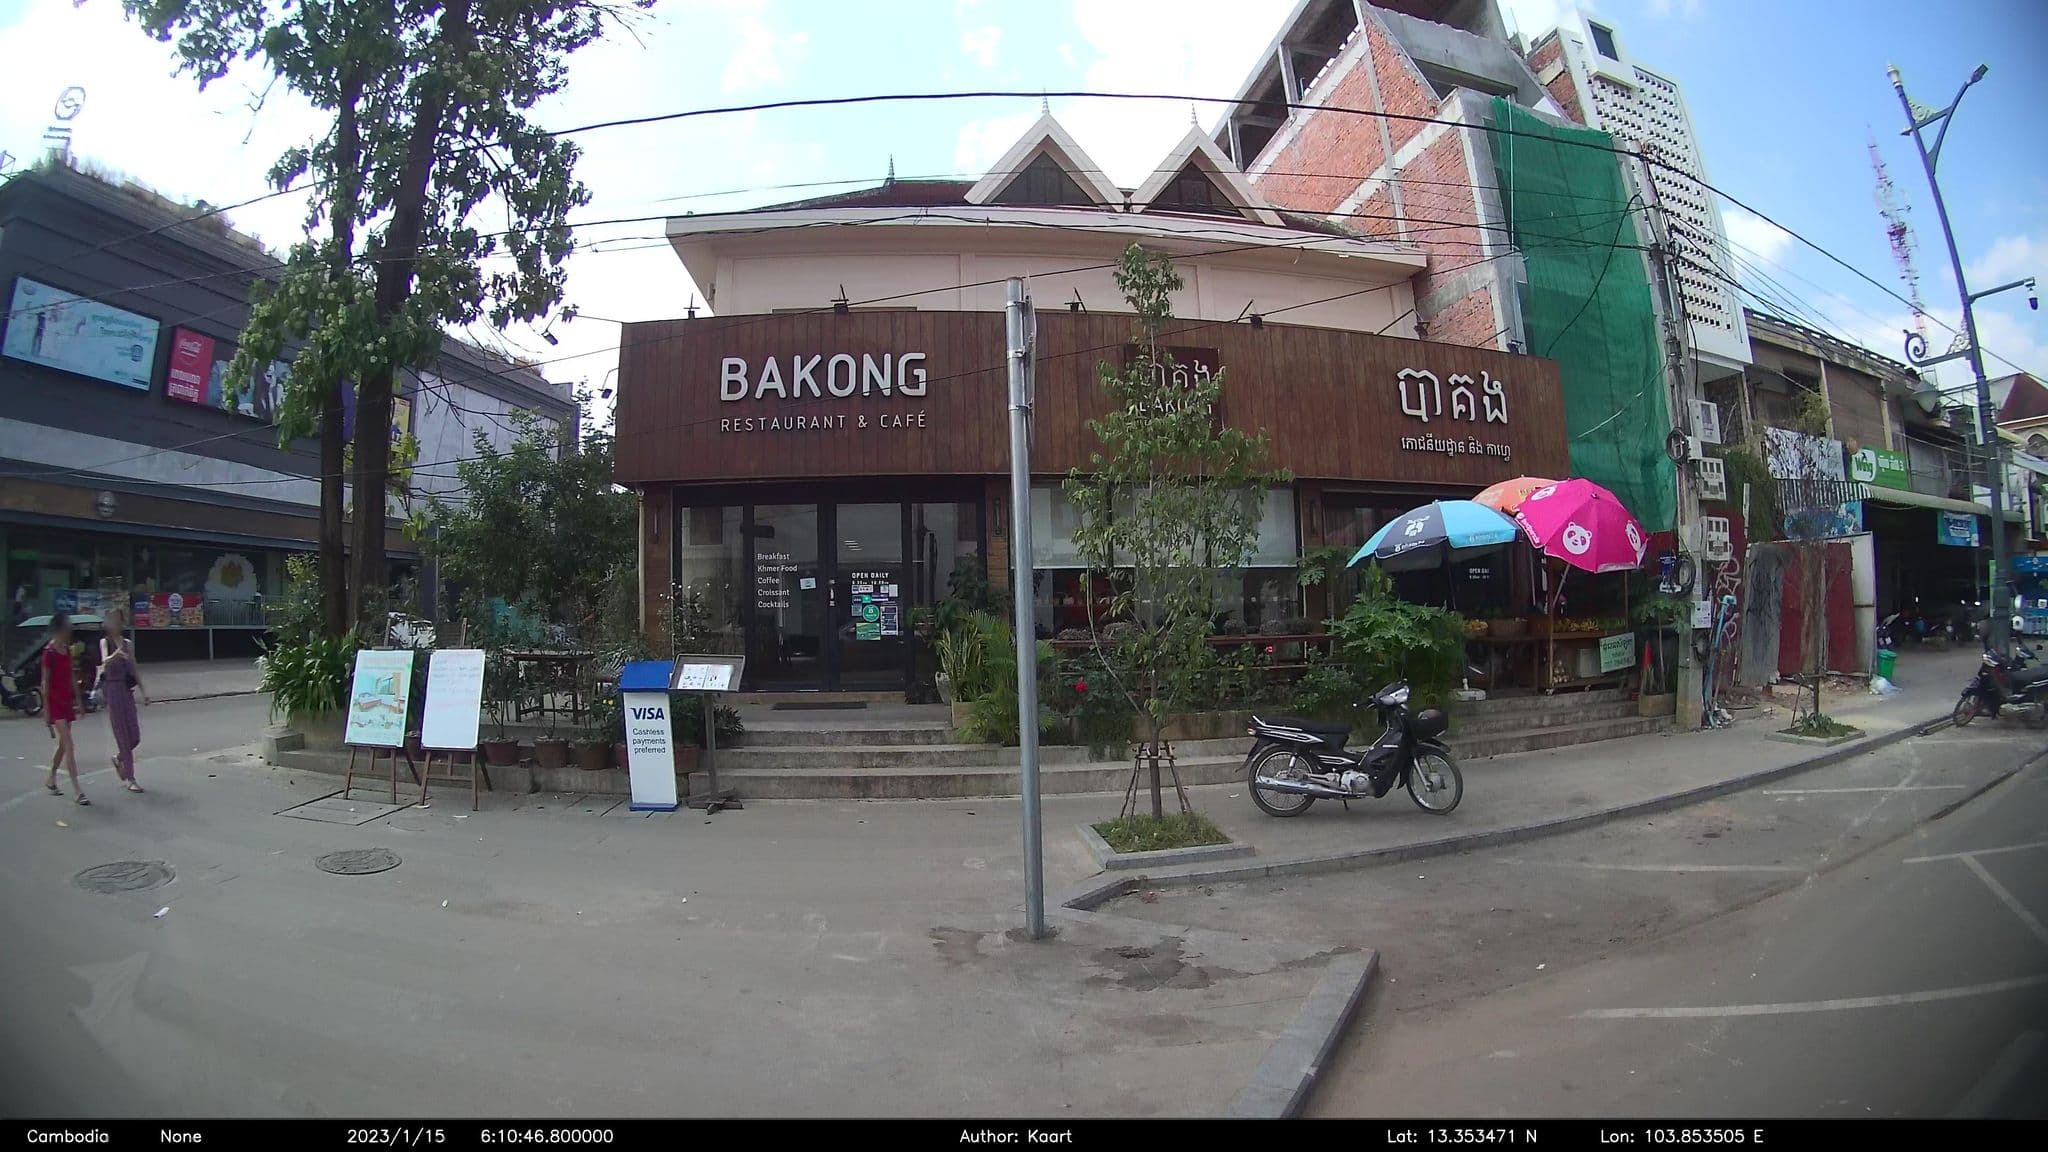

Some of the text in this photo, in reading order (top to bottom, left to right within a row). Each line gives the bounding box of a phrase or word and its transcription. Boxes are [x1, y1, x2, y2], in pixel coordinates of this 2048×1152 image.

[720, 353, 927, 401] BAKONG
[721, 410, 926, 432] RESTAURANT & CAFÉ
[757, 552, 791, 561] Breakfast
[757, 564, 798, 572] Khmer Food
[757, 576, 780, 584] Coffee
[757, 588, 790, 596] Croissant
[757, 600, 790, 608] Cocktails
[630, 707, 665, 720] VISA
[632, 728, 665, 736] Cashless
[632, 738, 666, 746] payments
[634, 746, 666, 754] preferred
